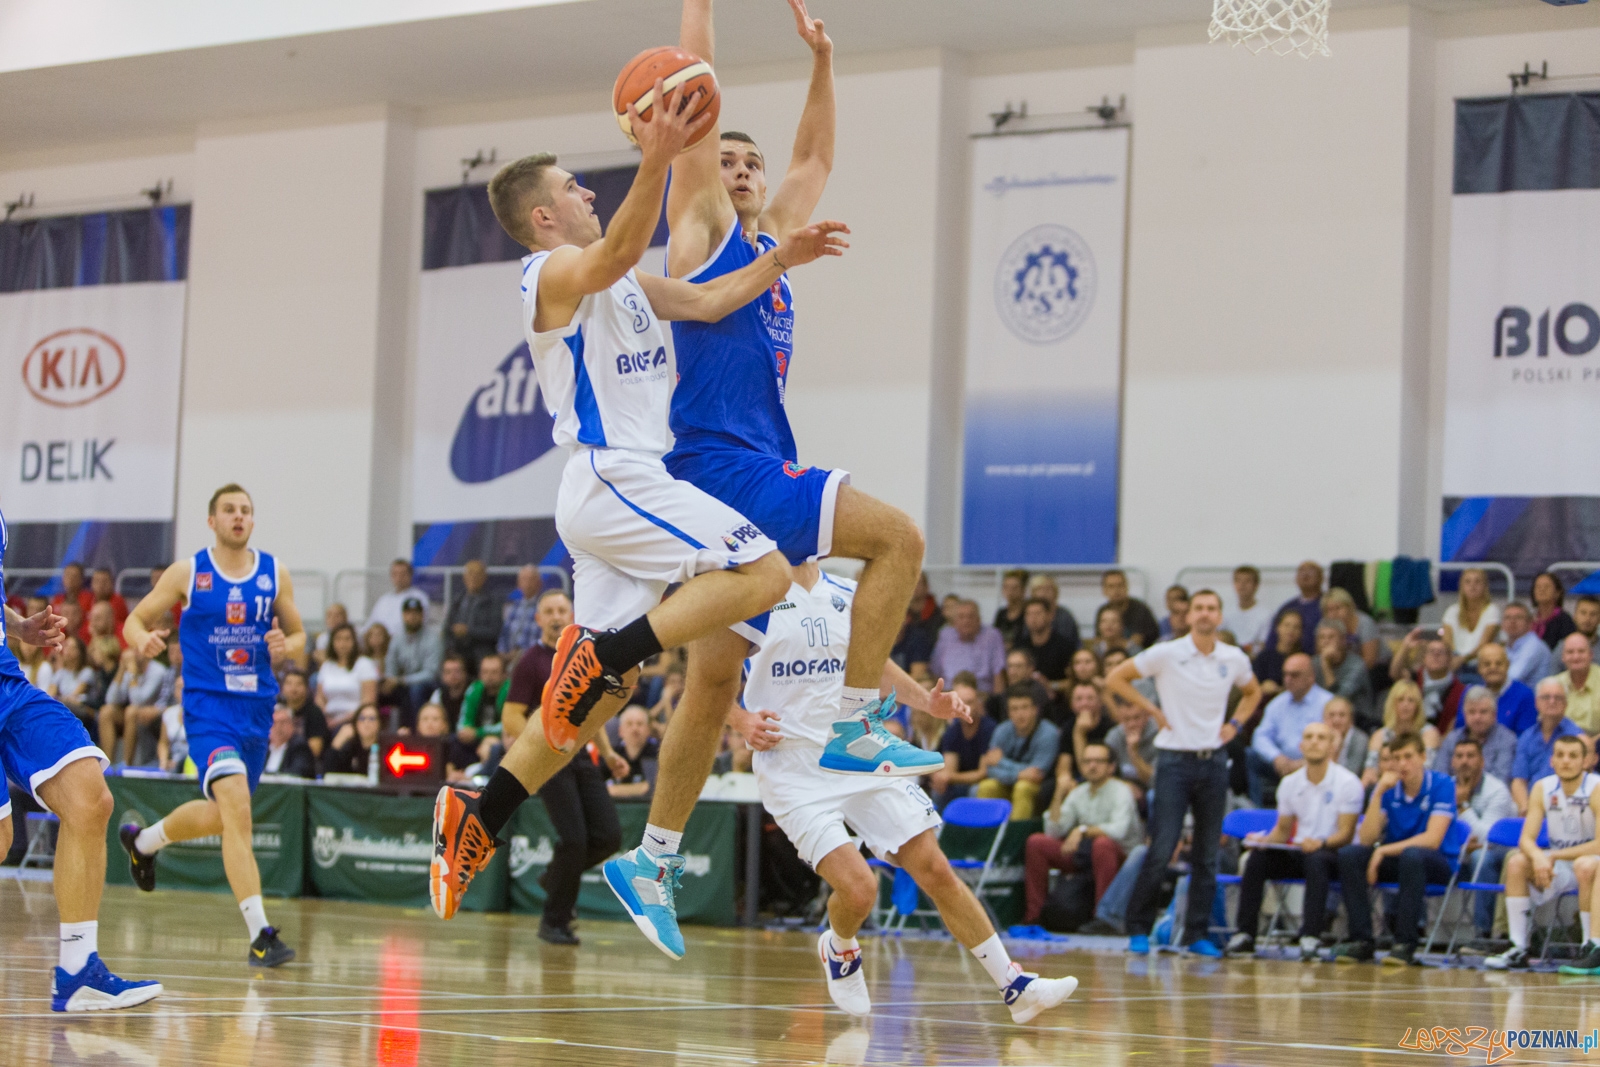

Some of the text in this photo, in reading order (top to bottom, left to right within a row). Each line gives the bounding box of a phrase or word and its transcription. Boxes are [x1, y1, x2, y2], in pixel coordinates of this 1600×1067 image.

[623, 293, 650, 334] 3
[1493, 302, 1600, 358] BIO
[40, 346, 104, 391] KIA
[20, 437, 117, 483] DELIK
[254, 595, 272, 622] 11
[801, 616, 829, 648] 11
